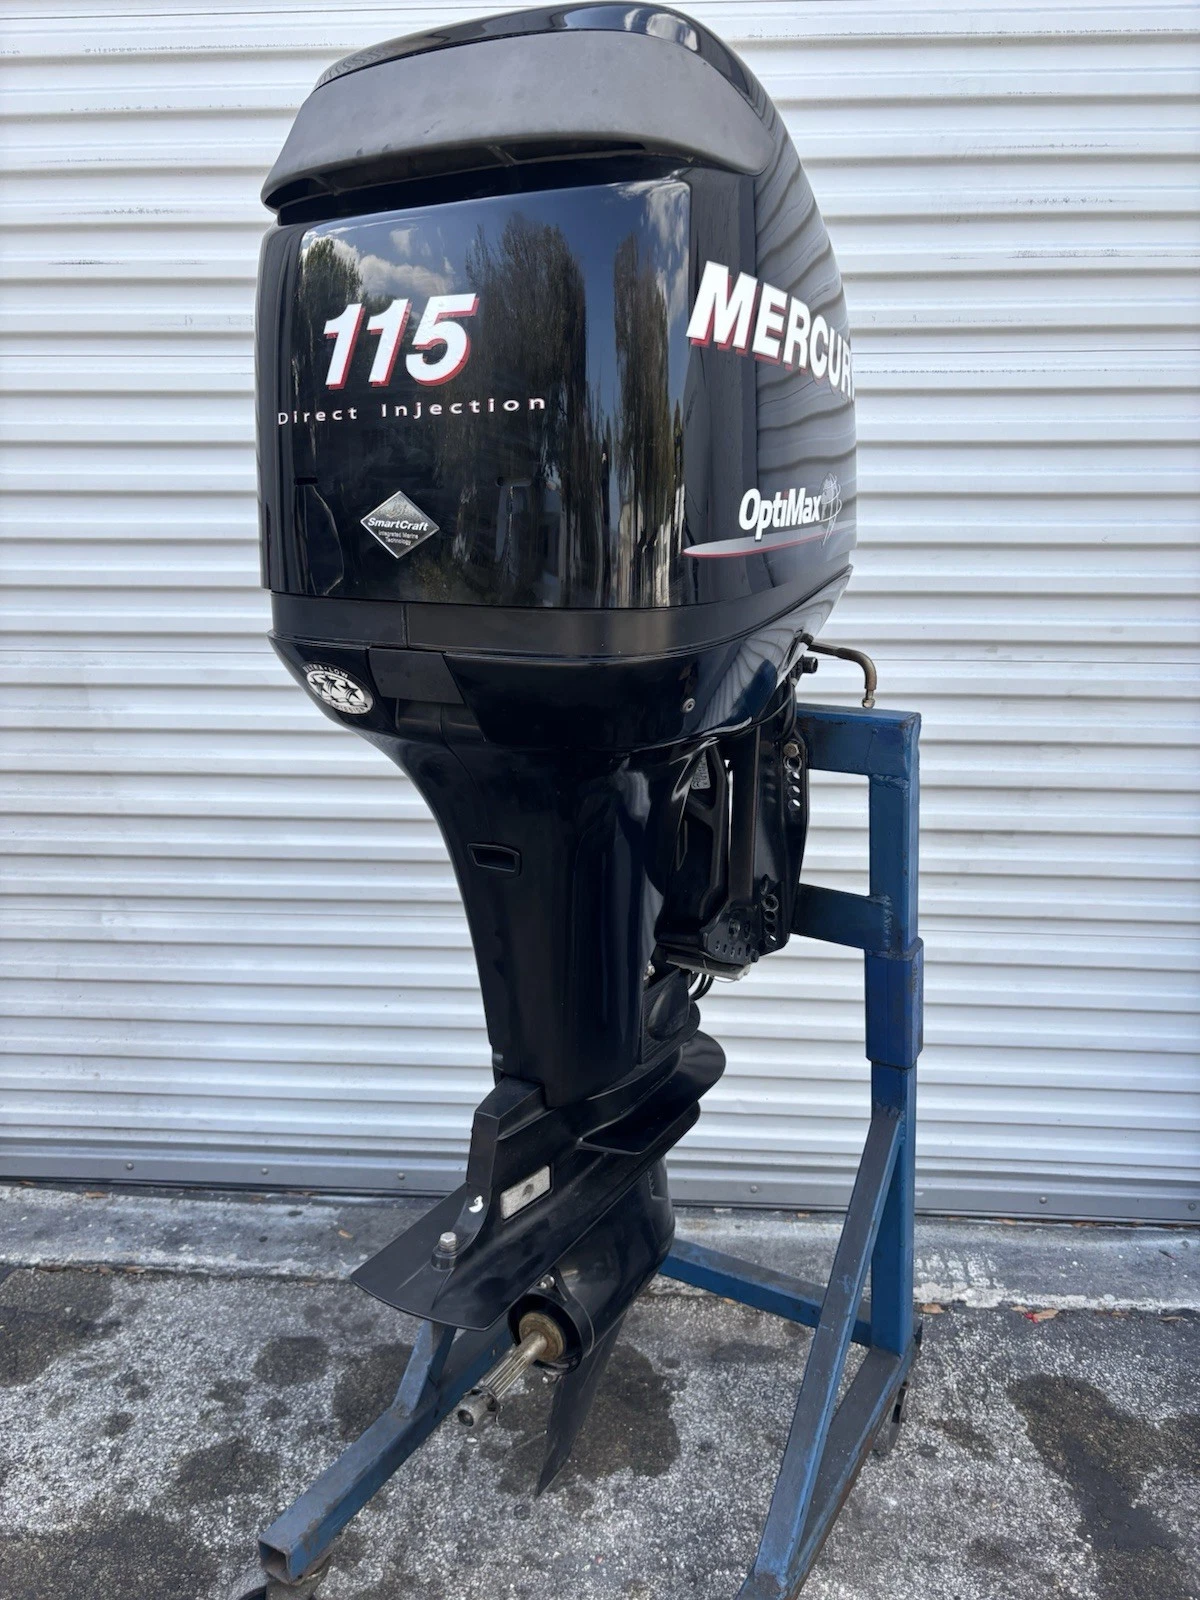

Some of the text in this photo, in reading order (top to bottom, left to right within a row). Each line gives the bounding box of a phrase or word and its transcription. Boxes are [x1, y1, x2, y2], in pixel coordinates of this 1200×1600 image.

[324, 293, 479, 390] 115
[686, 260, 855, 401] MERCUR
[278, 397, 546, 426] Direct Injection
[367, 517, 429, 532] SmartCraft
[739, 487, 822, 541] OptiMax
